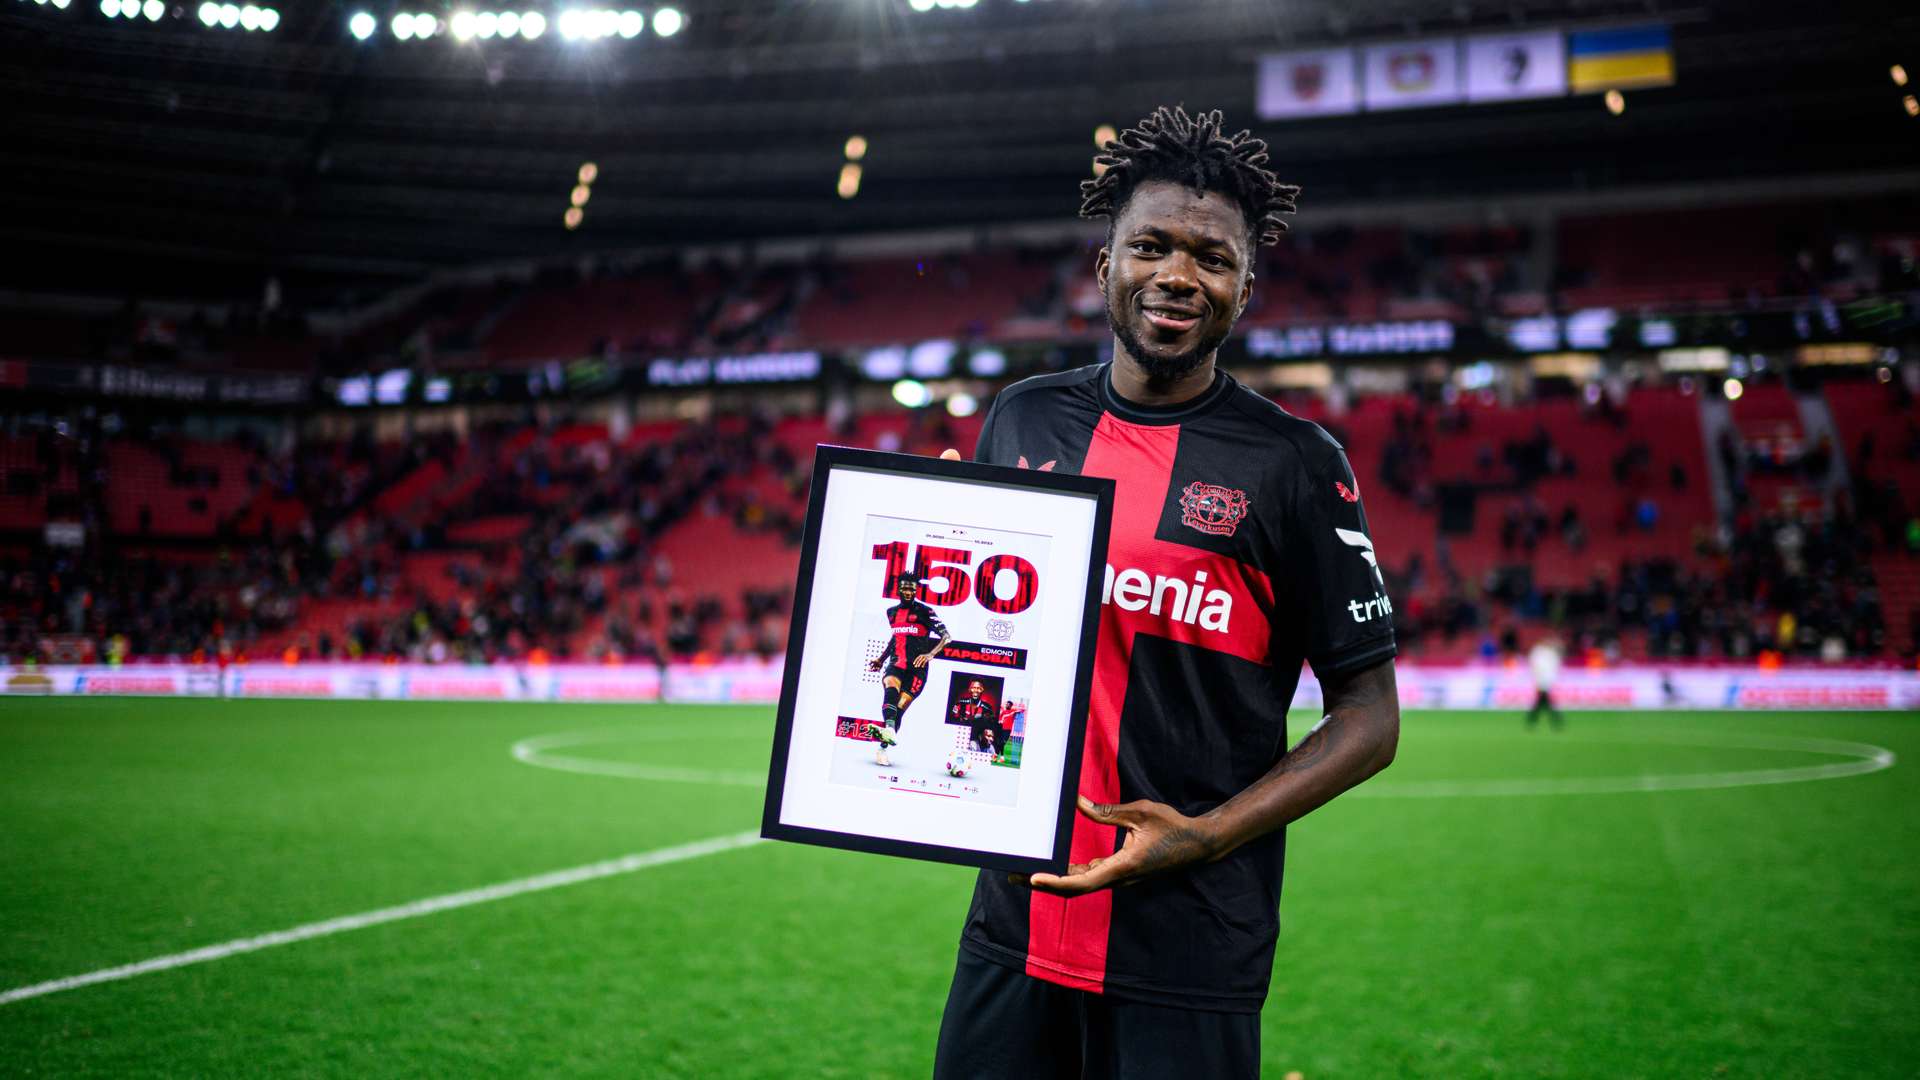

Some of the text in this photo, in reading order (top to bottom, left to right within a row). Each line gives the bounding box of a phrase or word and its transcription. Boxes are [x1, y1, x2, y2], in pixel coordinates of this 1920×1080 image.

[872, 541, 1039, 614] 150
[943, 647, 1012, 665] TAPSOBA
[980, 647, 1013, 657] EDMOND
[838, 720, 873, 738] #12
